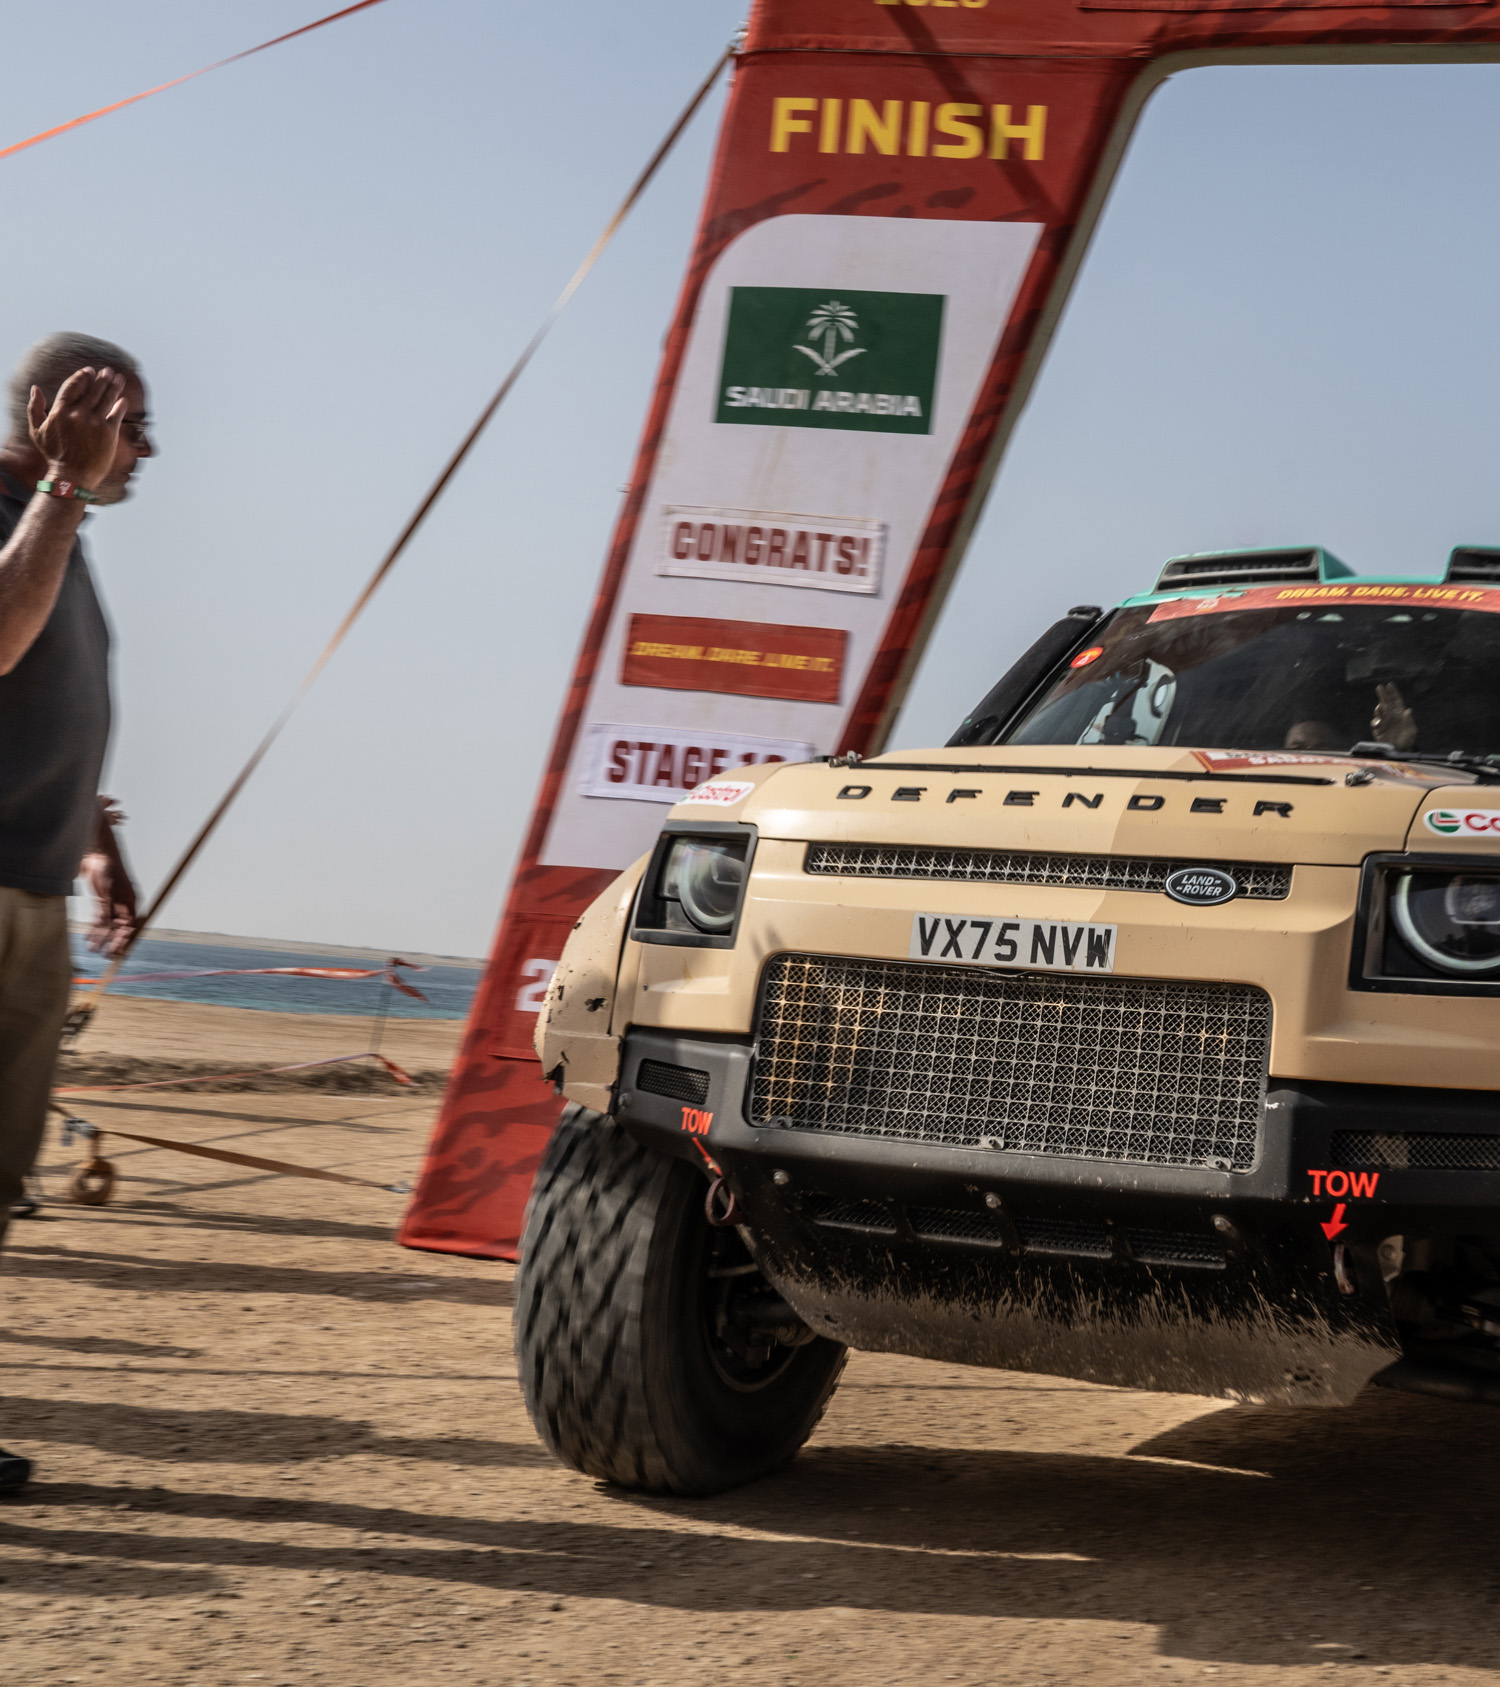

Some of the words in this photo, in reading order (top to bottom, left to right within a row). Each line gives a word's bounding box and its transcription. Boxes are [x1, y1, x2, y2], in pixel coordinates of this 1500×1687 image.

[769, 96, 1048, 161] FINISH
[724, 385, 810, 411] SAUDI
[810, 391, 923, 417] ARABIA
[671, 520, 873, 577] CONGRATS!
[1412, 587, 1459, 600] LIVE
[608, 739, 731, 791] STAGE
[836, 784, 1296, 818] DEFENDER
[917, 915, 1018, 963] VX75
[1031, 923, 1113, 969] NVW
[681, 1106, 714, 1136] TOW
[1307, 1169, 1380, 1198] TOW
